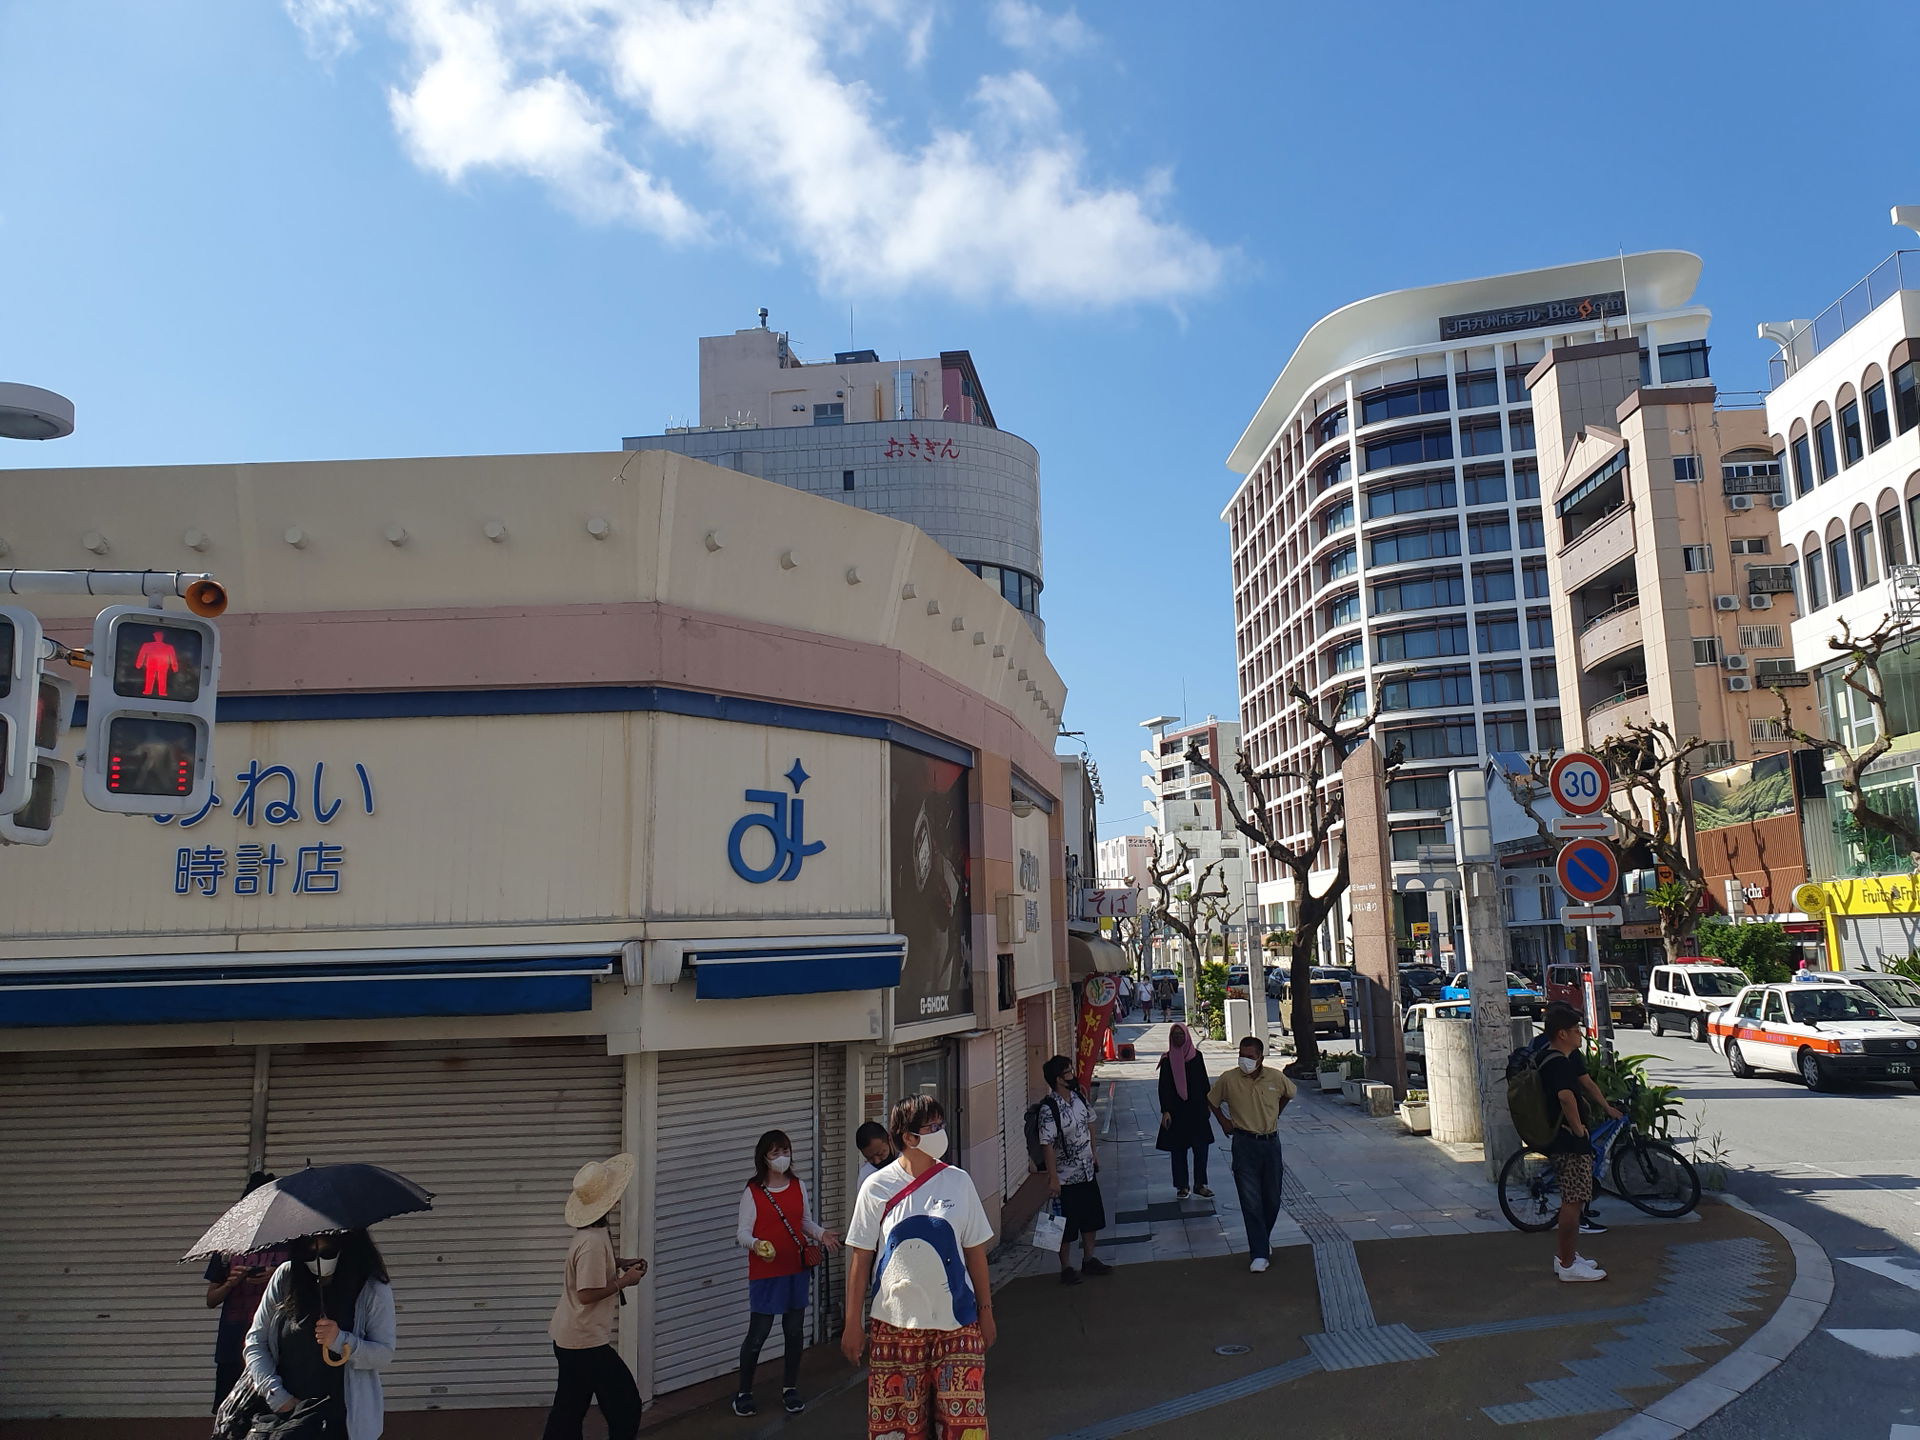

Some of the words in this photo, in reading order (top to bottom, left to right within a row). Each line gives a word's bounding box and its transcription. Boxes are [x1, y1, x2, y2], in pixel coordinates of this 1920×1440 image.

[884, 433, 960, 462] おきぎん
[1564, 771, 1597, 797] 30
[174, 841, 344, 896] 時計店
[1088, 891, 1131, 915] そば
[920, 995, 949, 1015] G-SHOCK
